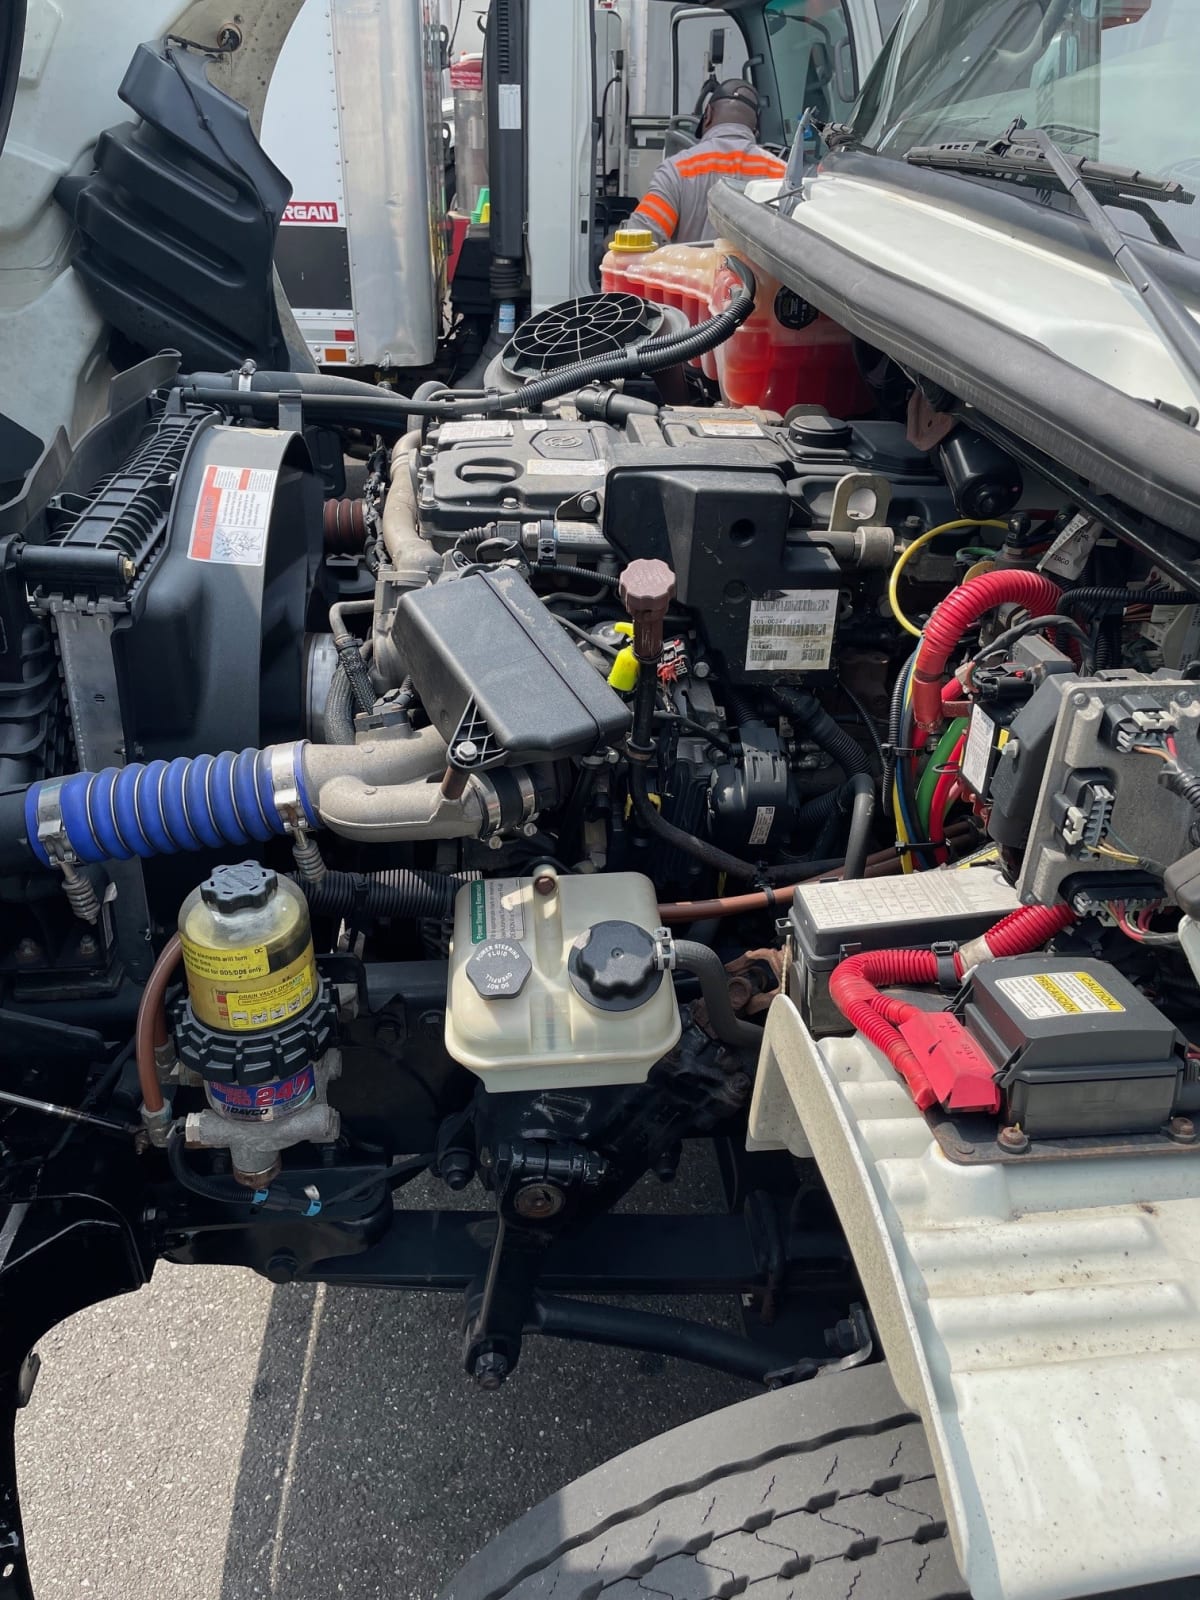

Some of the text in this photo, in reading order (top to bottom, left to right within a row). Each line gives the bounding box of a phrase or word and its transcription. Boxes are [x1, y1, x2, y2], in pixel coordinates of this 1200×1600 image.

[475, 904, 484, 924] Steering
[475, 924, 484, 940] Power
[475, 943, 520, 960] POWER STEERING
[487, 950, 508, 958] FLUID
[485, 972, 513, 984] OVERFILL
[1081, 977, 1117, 1006] CAUTION
[230, 1107, 268, 1116] DAVCO
